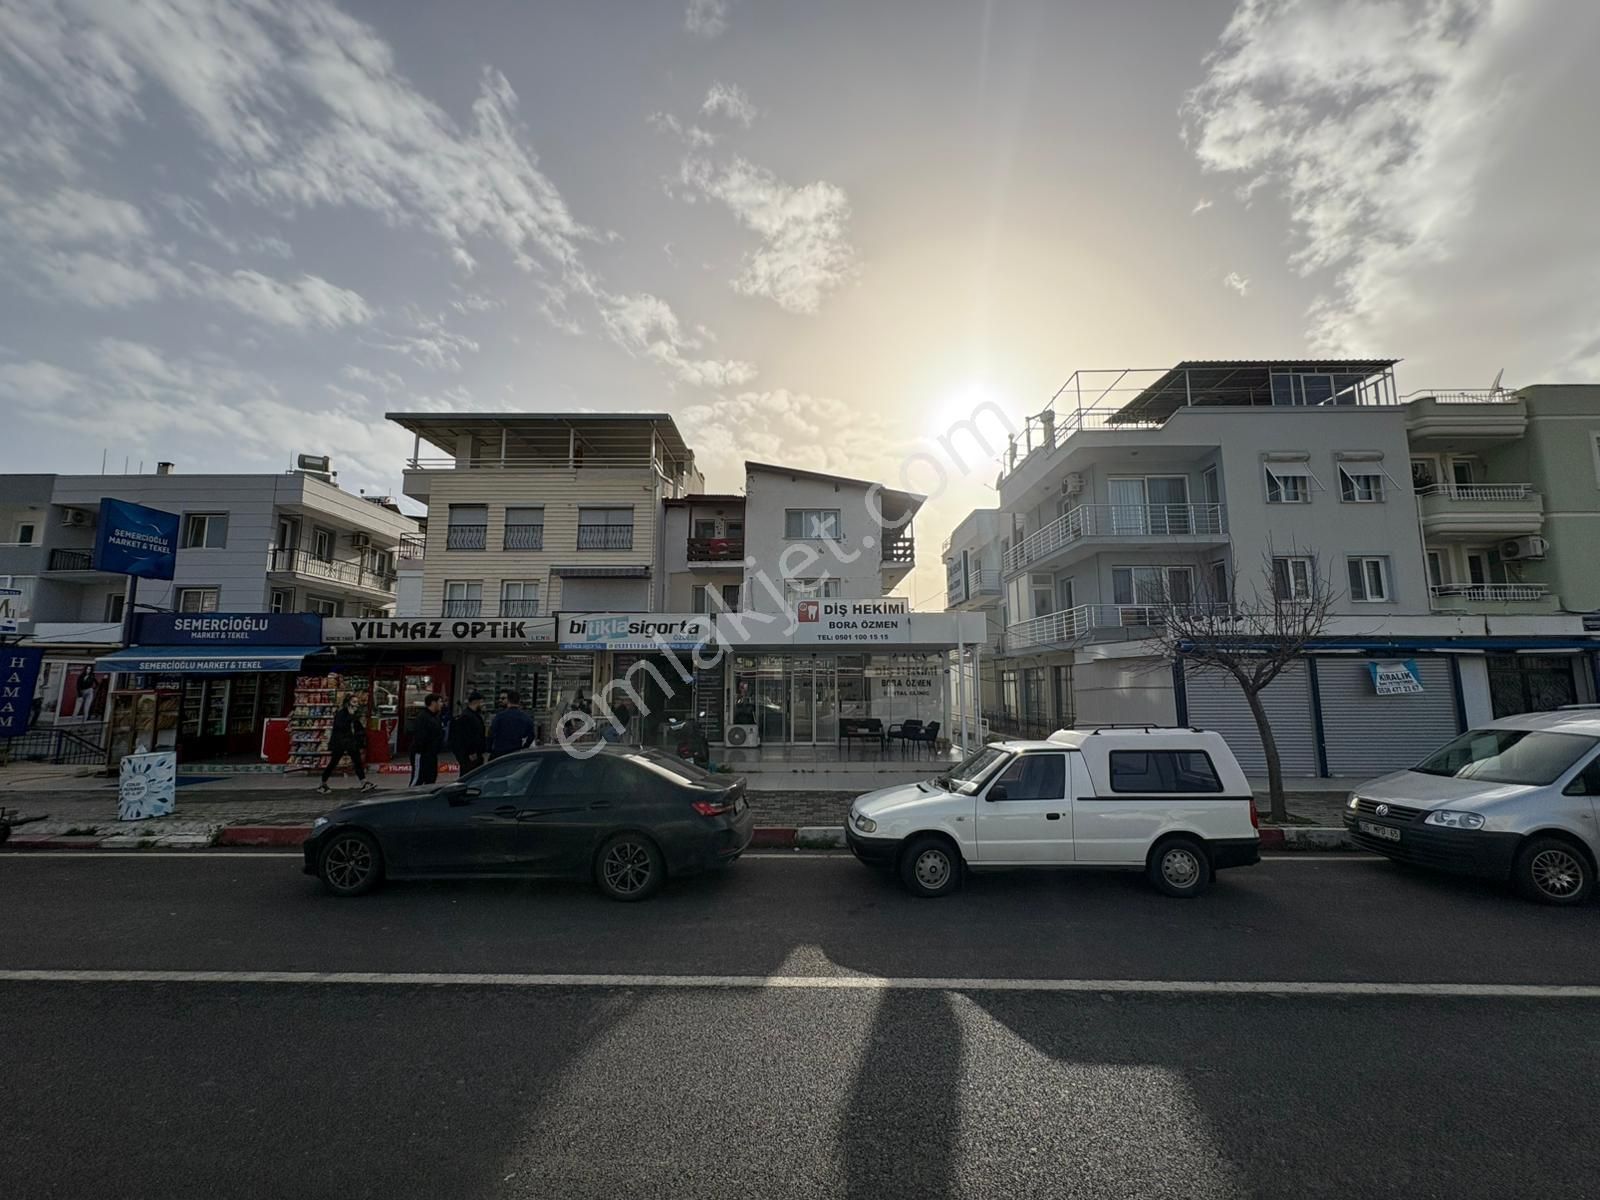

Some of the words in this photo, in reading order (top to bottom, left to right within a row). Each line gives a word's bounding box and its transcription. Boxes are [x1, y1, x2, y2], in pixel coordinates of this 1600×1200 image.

[108, 536, 141, 549] MARKET
[149, 543, 171, 554] TEKEL
[824, 602, 848, 617] DİŞ
[852, 602, 905, 615] HEKİMİ
[174, 616, 269, 631] SEMERCİOĞLU
[828, 621, 858, 629] BORA
[861, 619, 899, 629] ÖZMEN
[191, 631, 219, 640] MARKET
[228, 631, 250, 640] TEKEL
[351, 621, 441, 640] YILMAZ
[197, 661, 228, 670] MARKET
[237, 661, 262, 669] TEKEL
[1379, 671, 1412, 682] KİRALIK
